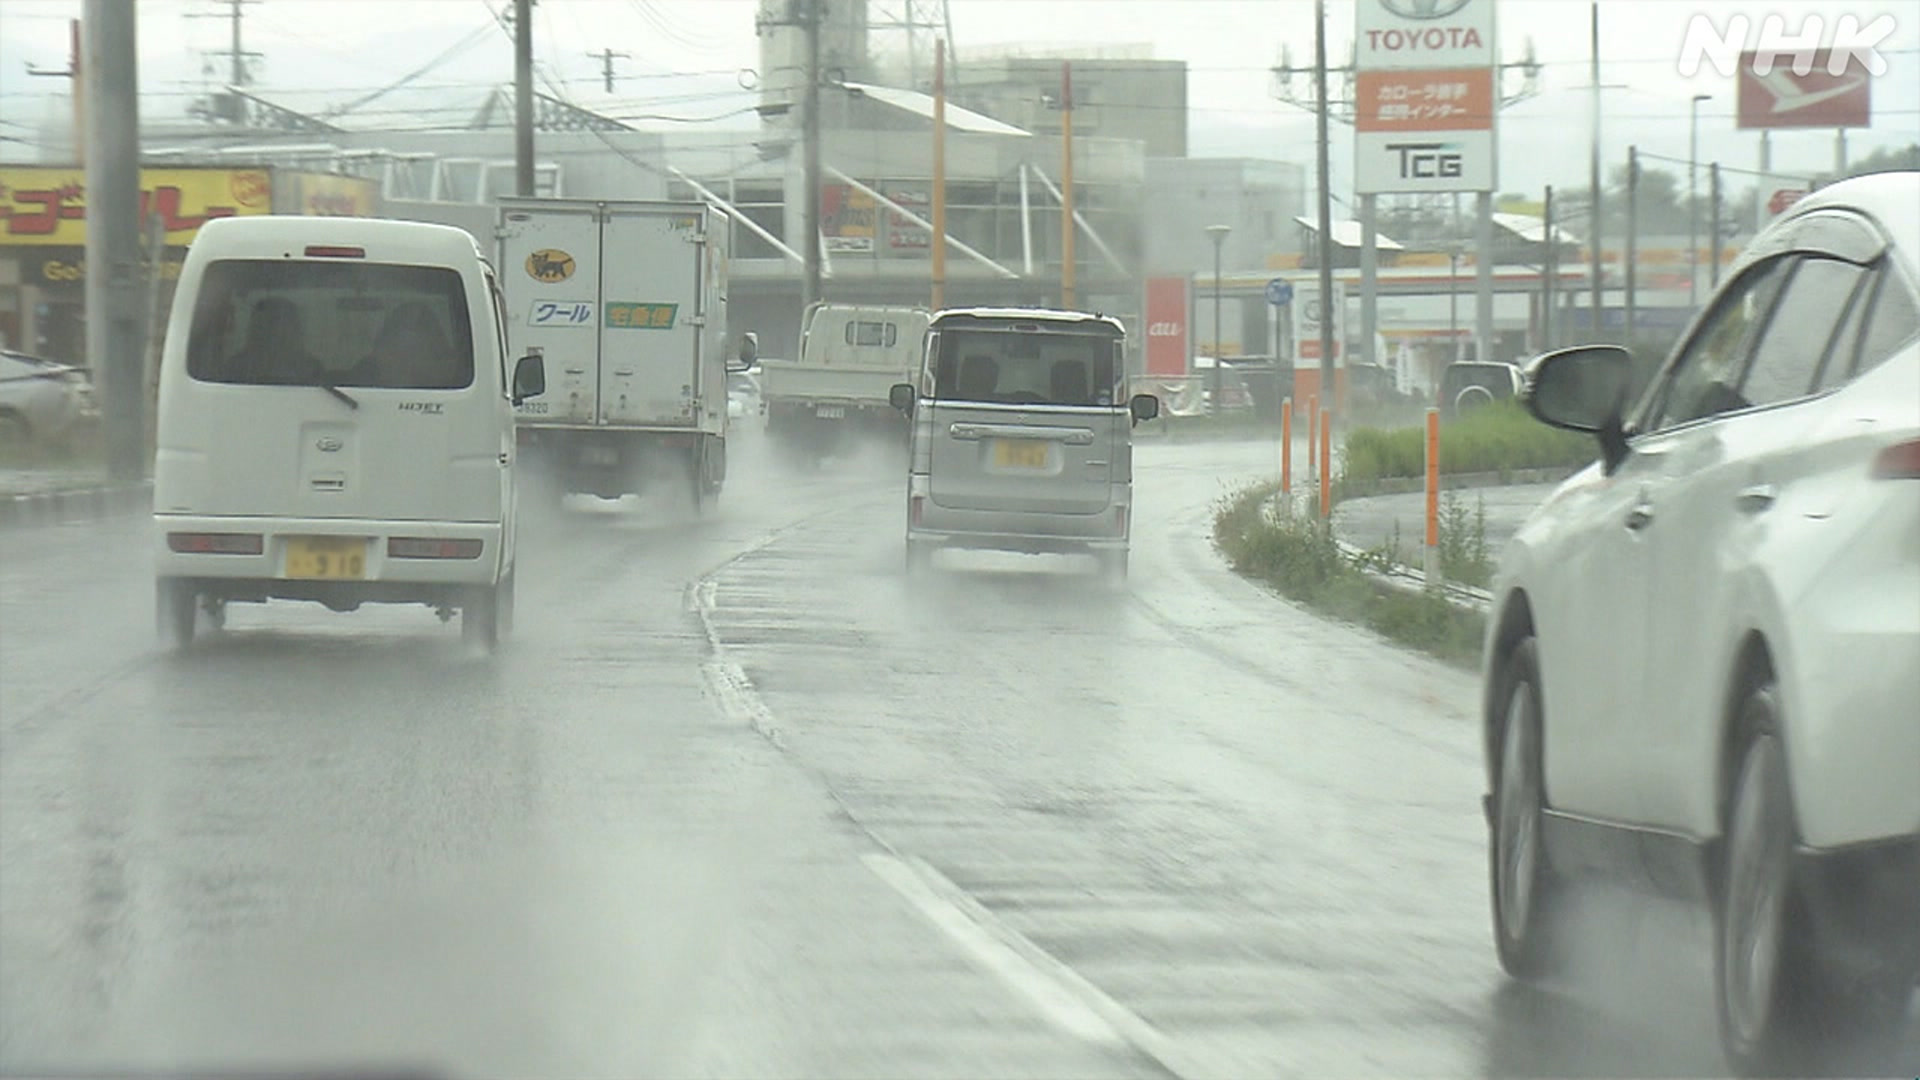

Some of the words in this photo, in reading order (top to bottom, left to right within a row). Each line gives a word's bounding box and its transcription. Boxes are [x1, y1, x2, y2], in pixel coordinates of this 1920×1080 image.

[1366, 27, 1483, 51] TOYOTA
[1385, 142, 1463, 178] TCG
[536, 303, 591, 323] クール
[1149, 321, 1183, 337] au
[398, 403, 444, 411] HIJET
